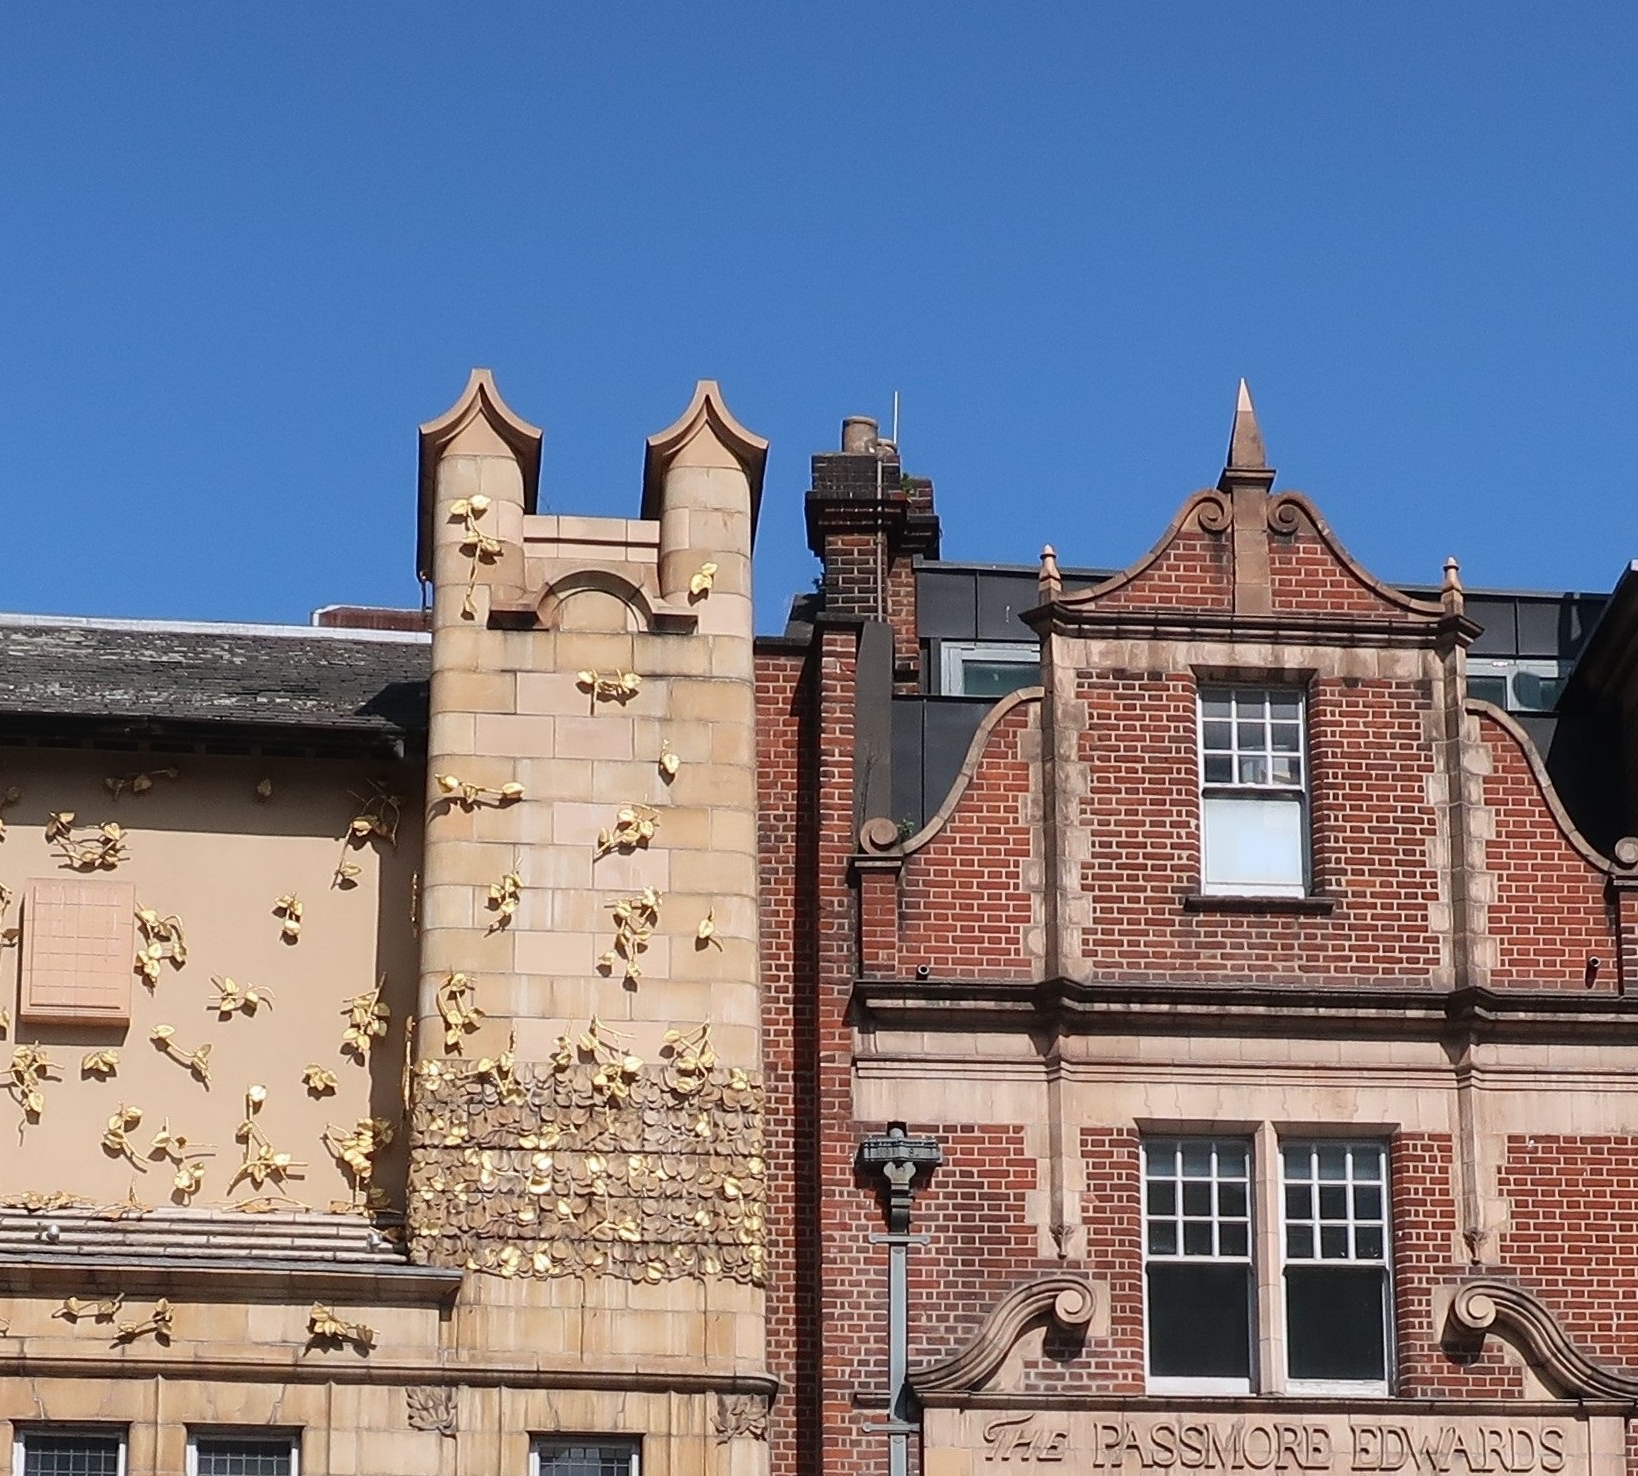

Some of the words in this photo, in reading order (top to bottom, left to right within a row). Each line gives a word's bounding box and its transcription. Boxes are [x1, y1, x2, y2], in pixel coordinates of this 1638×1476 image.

[982, 1412, 1068, 1462] THE
[1092, 1421, 1332, 1471] PASSMORE
[1350, 1423, 1566, 1473] EDWARDS
